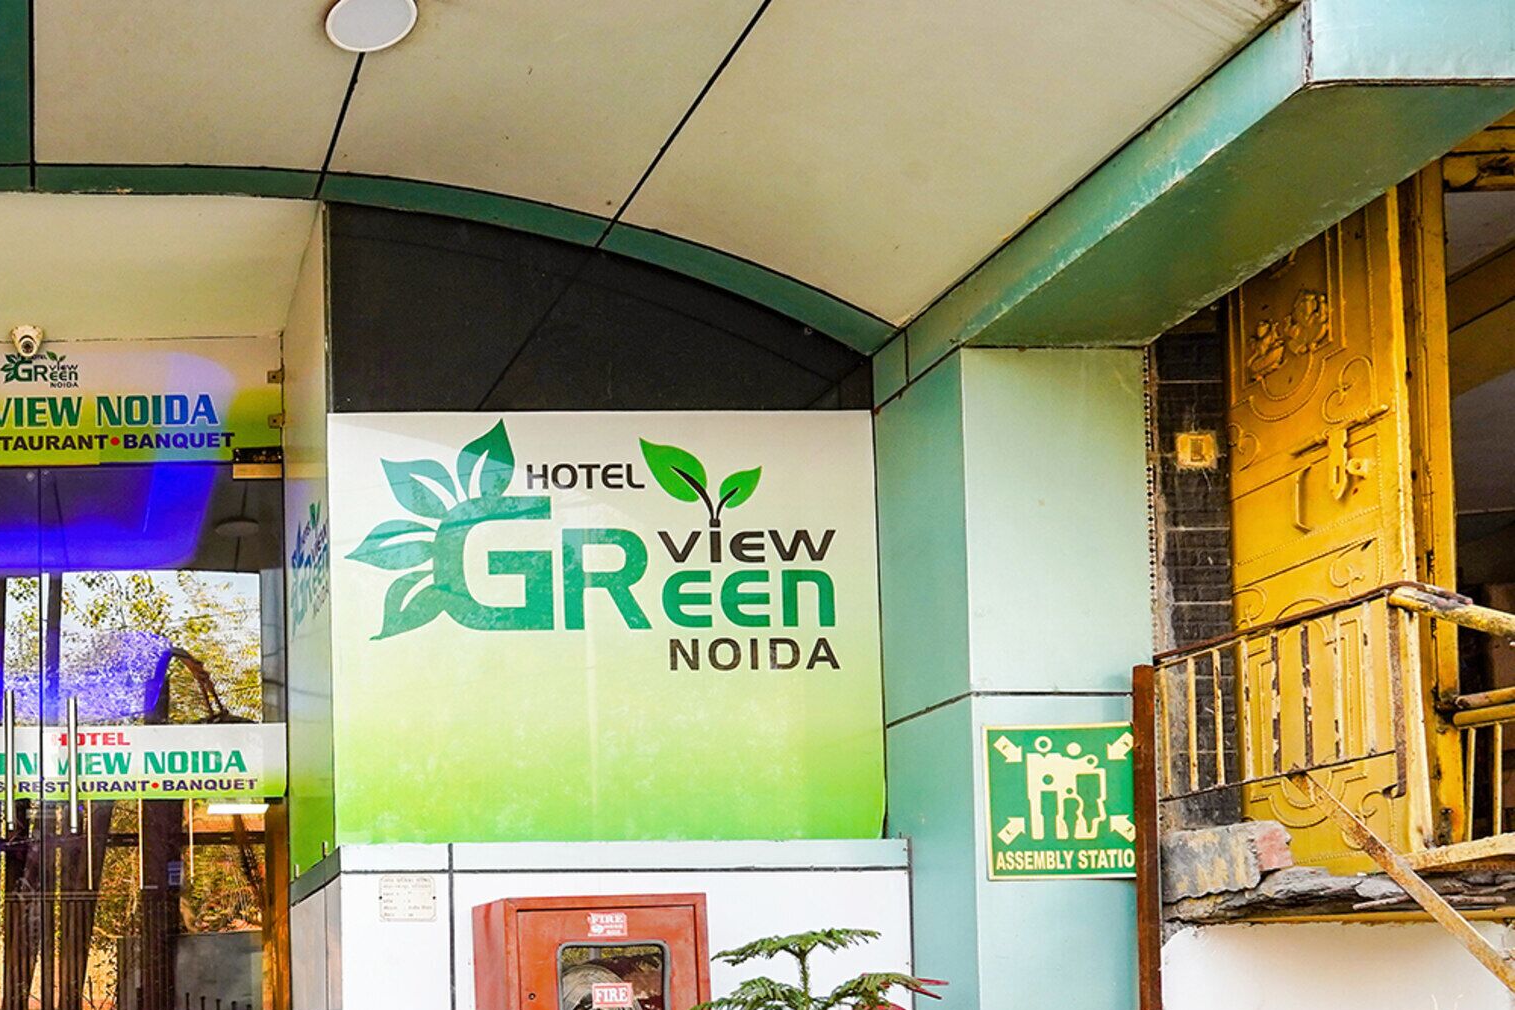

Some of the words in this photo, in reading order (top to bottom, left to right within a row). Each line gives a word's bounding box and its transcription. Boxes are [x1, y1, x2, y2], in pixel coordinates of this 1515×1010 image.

[96, 394, 219, 427] NOIDA
[123, 432, 236, 450] BANQUET
[526, 463, 646, 490] HOTEL
[669, 637, 840, 671] NOIDA
[144, 750, 247, 775] NOIDA
[18, 780, 149, 793] RESTURANT
[162, 778, 258, 792] BANQUET
[996, 850, 1074, 870] ASSEMBLY
[1078, 848, 1135, 869] STATIO
[591, 913, 624, 924] FIRE
[595, 987, 628, 1003] FIRE
